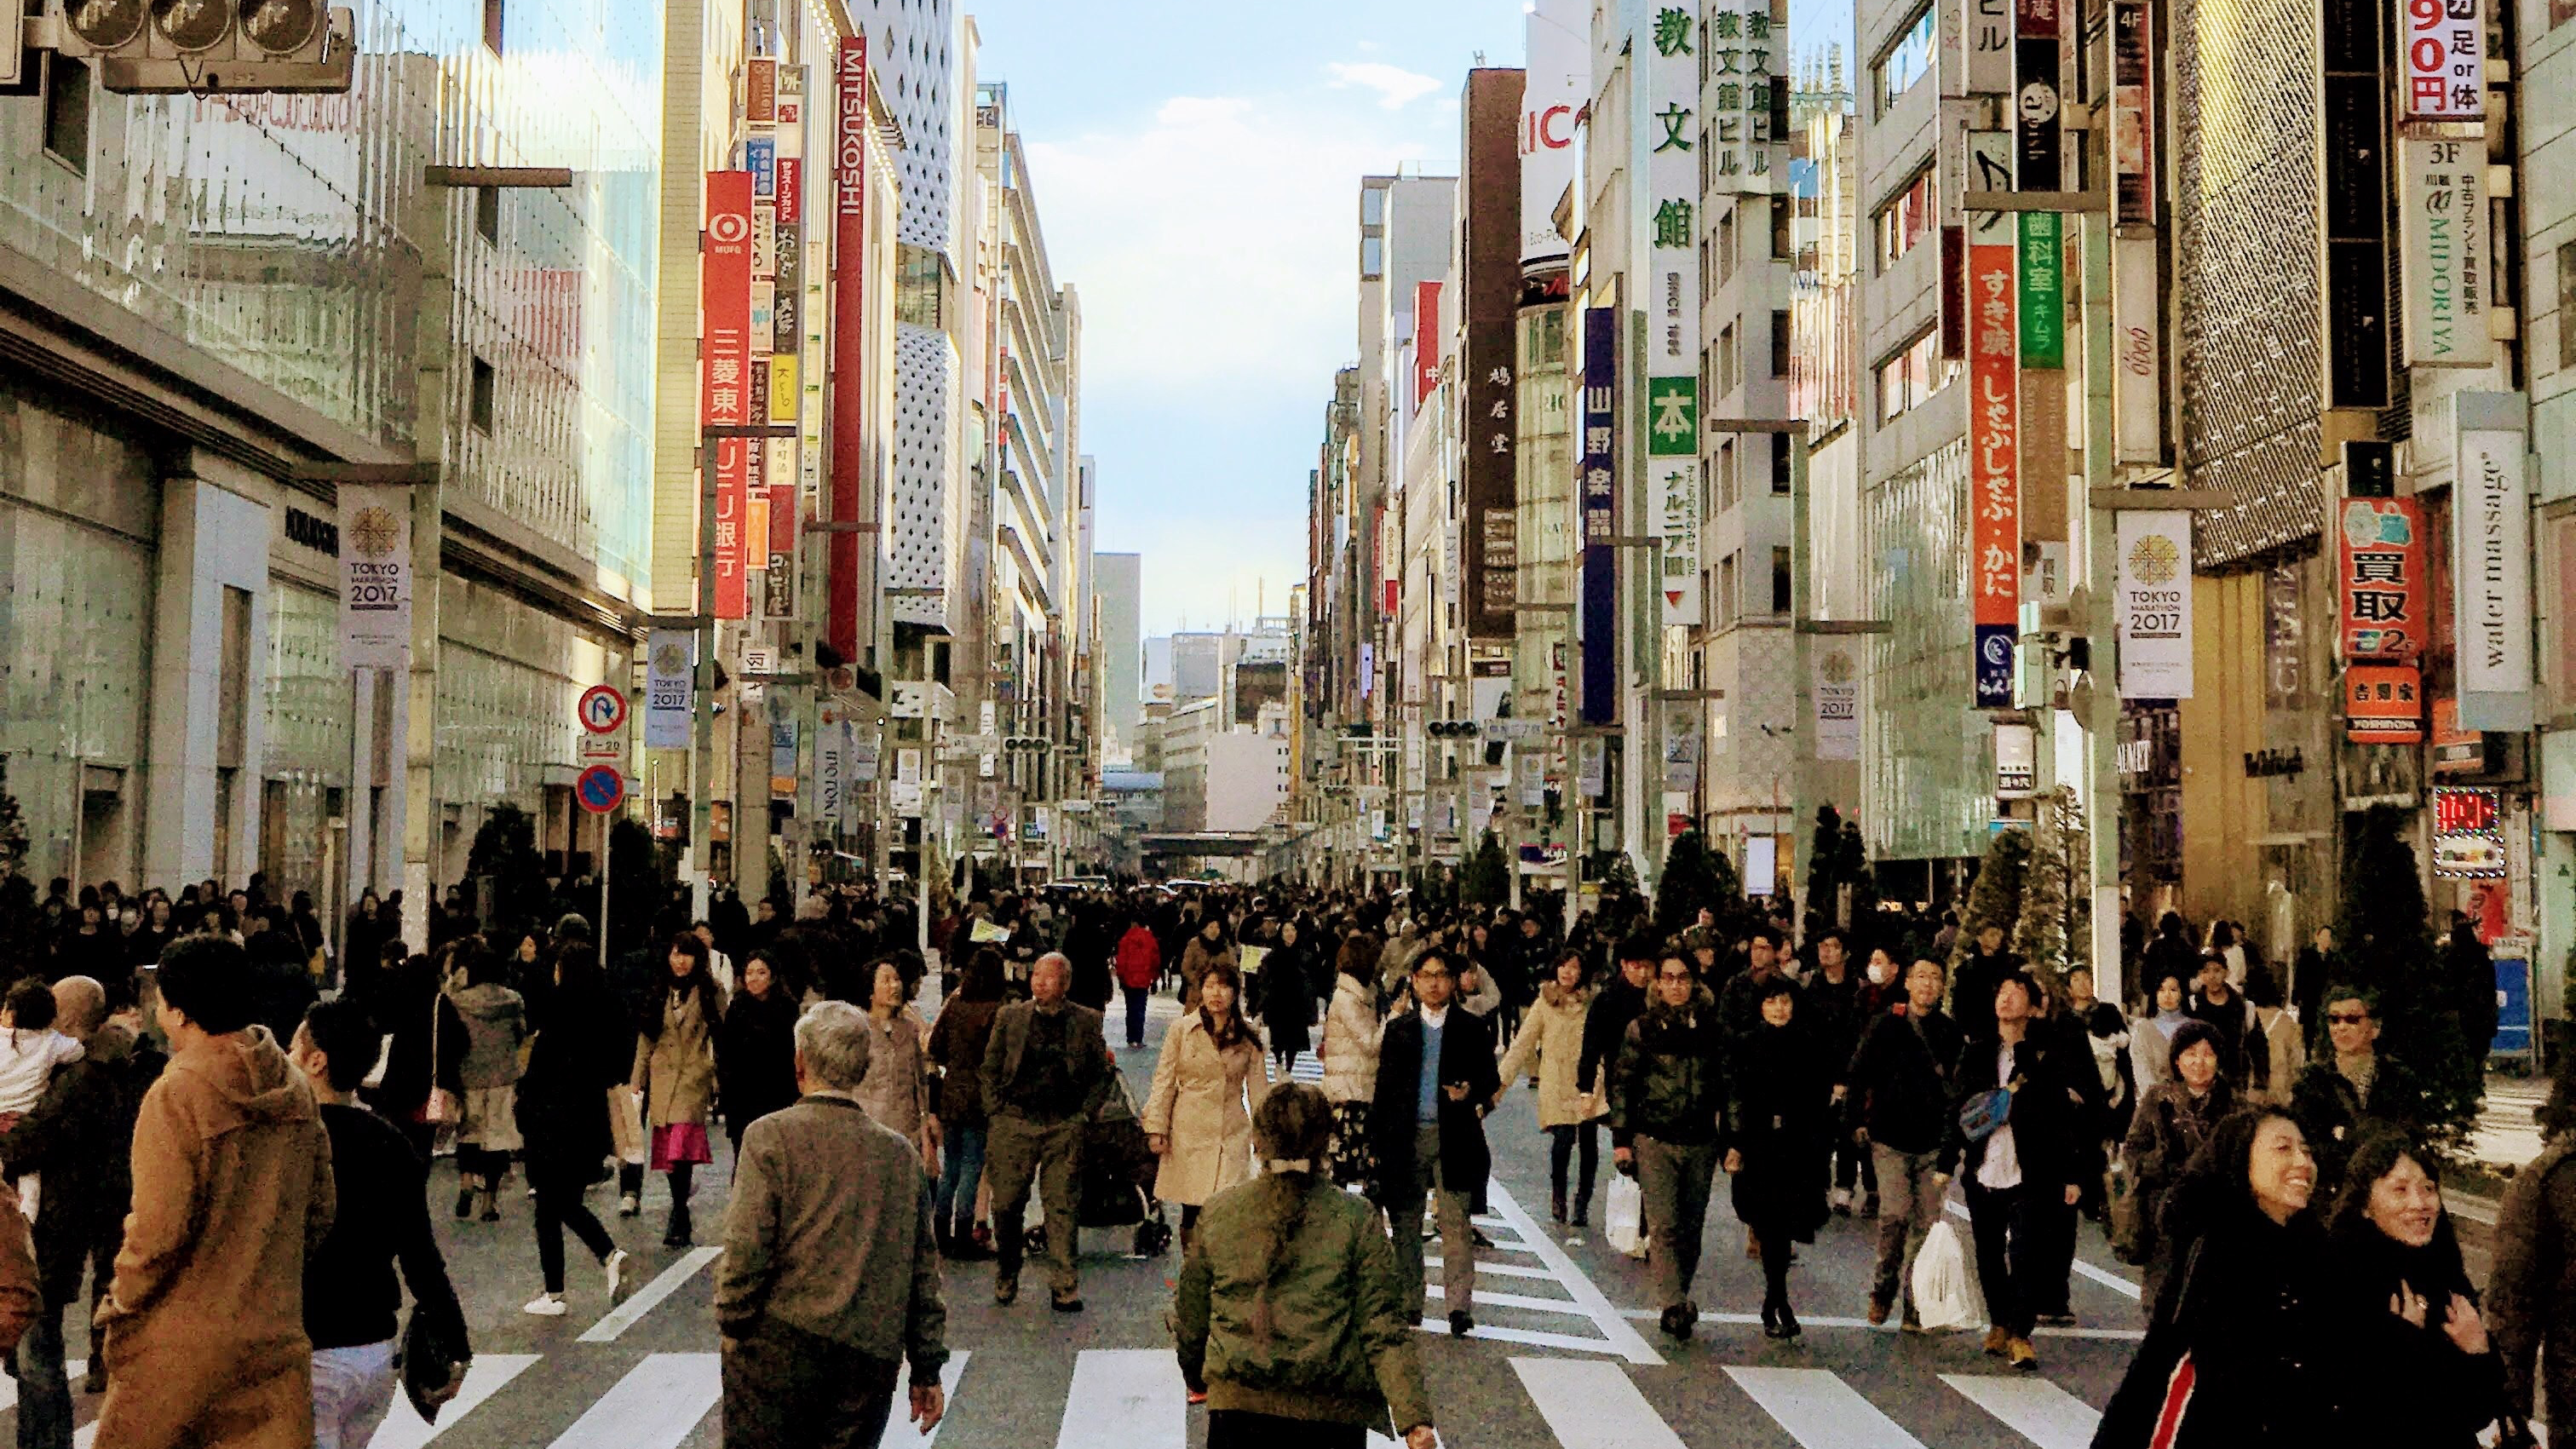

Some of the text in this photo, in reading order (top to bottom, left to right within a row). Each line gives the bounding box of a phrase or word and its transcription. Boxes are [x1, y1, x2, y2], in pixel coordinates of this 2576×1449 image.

[2119, 11, 2143, 28] 4F
[841, 49, 863, 215] MITSUKOSHI
[1653, 6, 1694, 250] 教文館
[2429, 143, 2461, 164] 3F
[2429, 218, 2454, 356] MIDORIYA
[1654, 388, 1693, 443] 本
[350, 562, 399, 575] TOKYO
[351, 585, 398, 602] 2017
[2130, 590, 2181, 603] TOKYO
[2352, 552, 2409, 624] 買取
[2130, 613, 2181, 630] 2017
[653, 694, 686, 705] 2017
[1821, 703, 1854, 715] 2017
